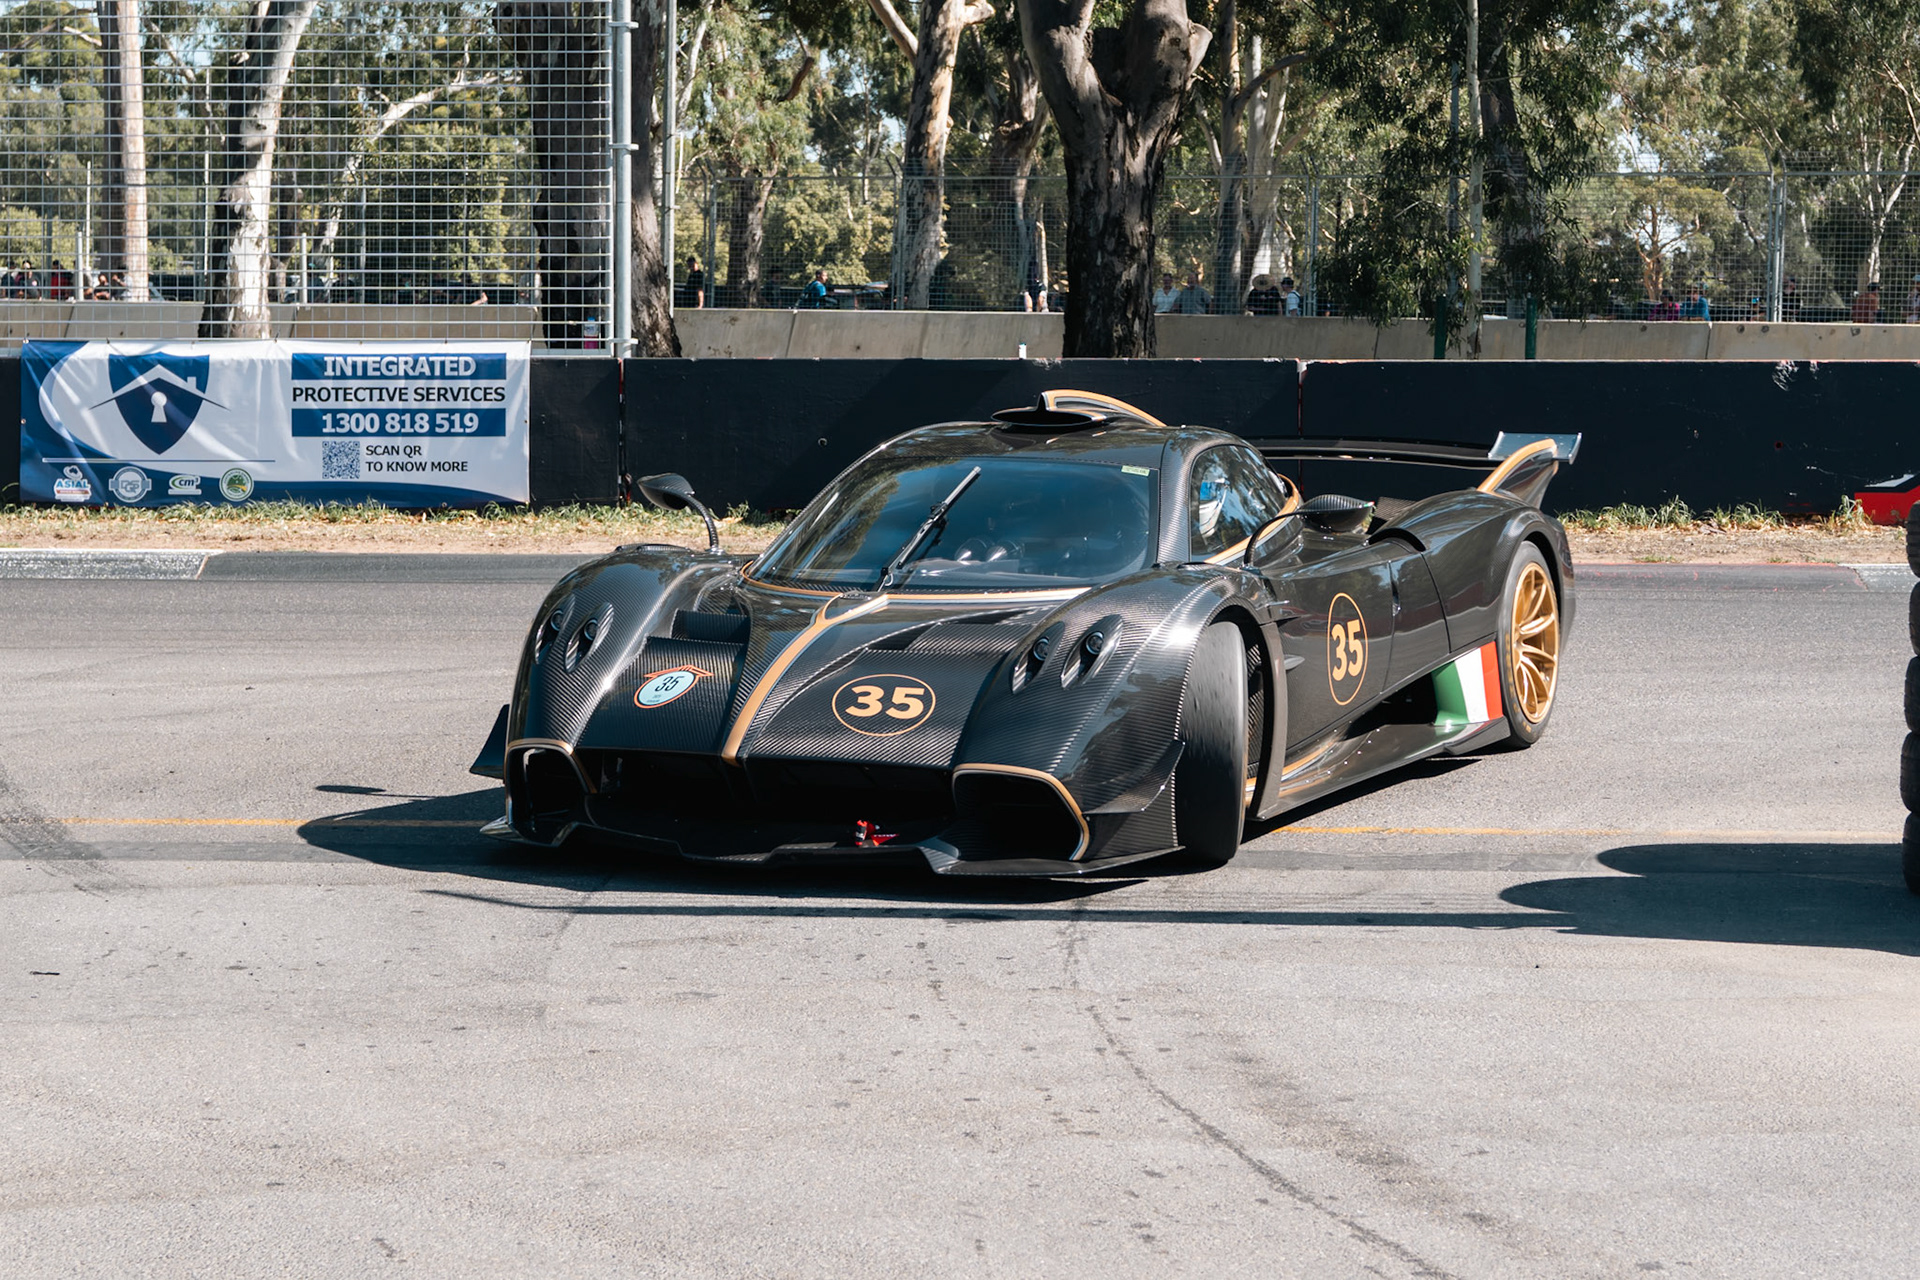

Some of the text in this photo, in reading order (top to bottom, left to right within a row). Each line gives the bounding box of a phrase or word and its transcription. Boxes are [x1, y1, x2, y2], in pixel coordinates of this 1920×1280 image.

[324, 356, 477, 377] INTEGRATED
[292, 387, 506, 402] PROTECTIVE SERVICES
[322, 412, 479, 433] 1300 818 519
[366, 445, 422, 458] SCAN QR
[366, 461, 468, 472] TO KNOW MORE
[56, 480, 89, 488] ASIAL
[1331, 619, 1364, 682] 35
[655, 676, 685, 692] 35
[845, 685, 925, 720] 35
